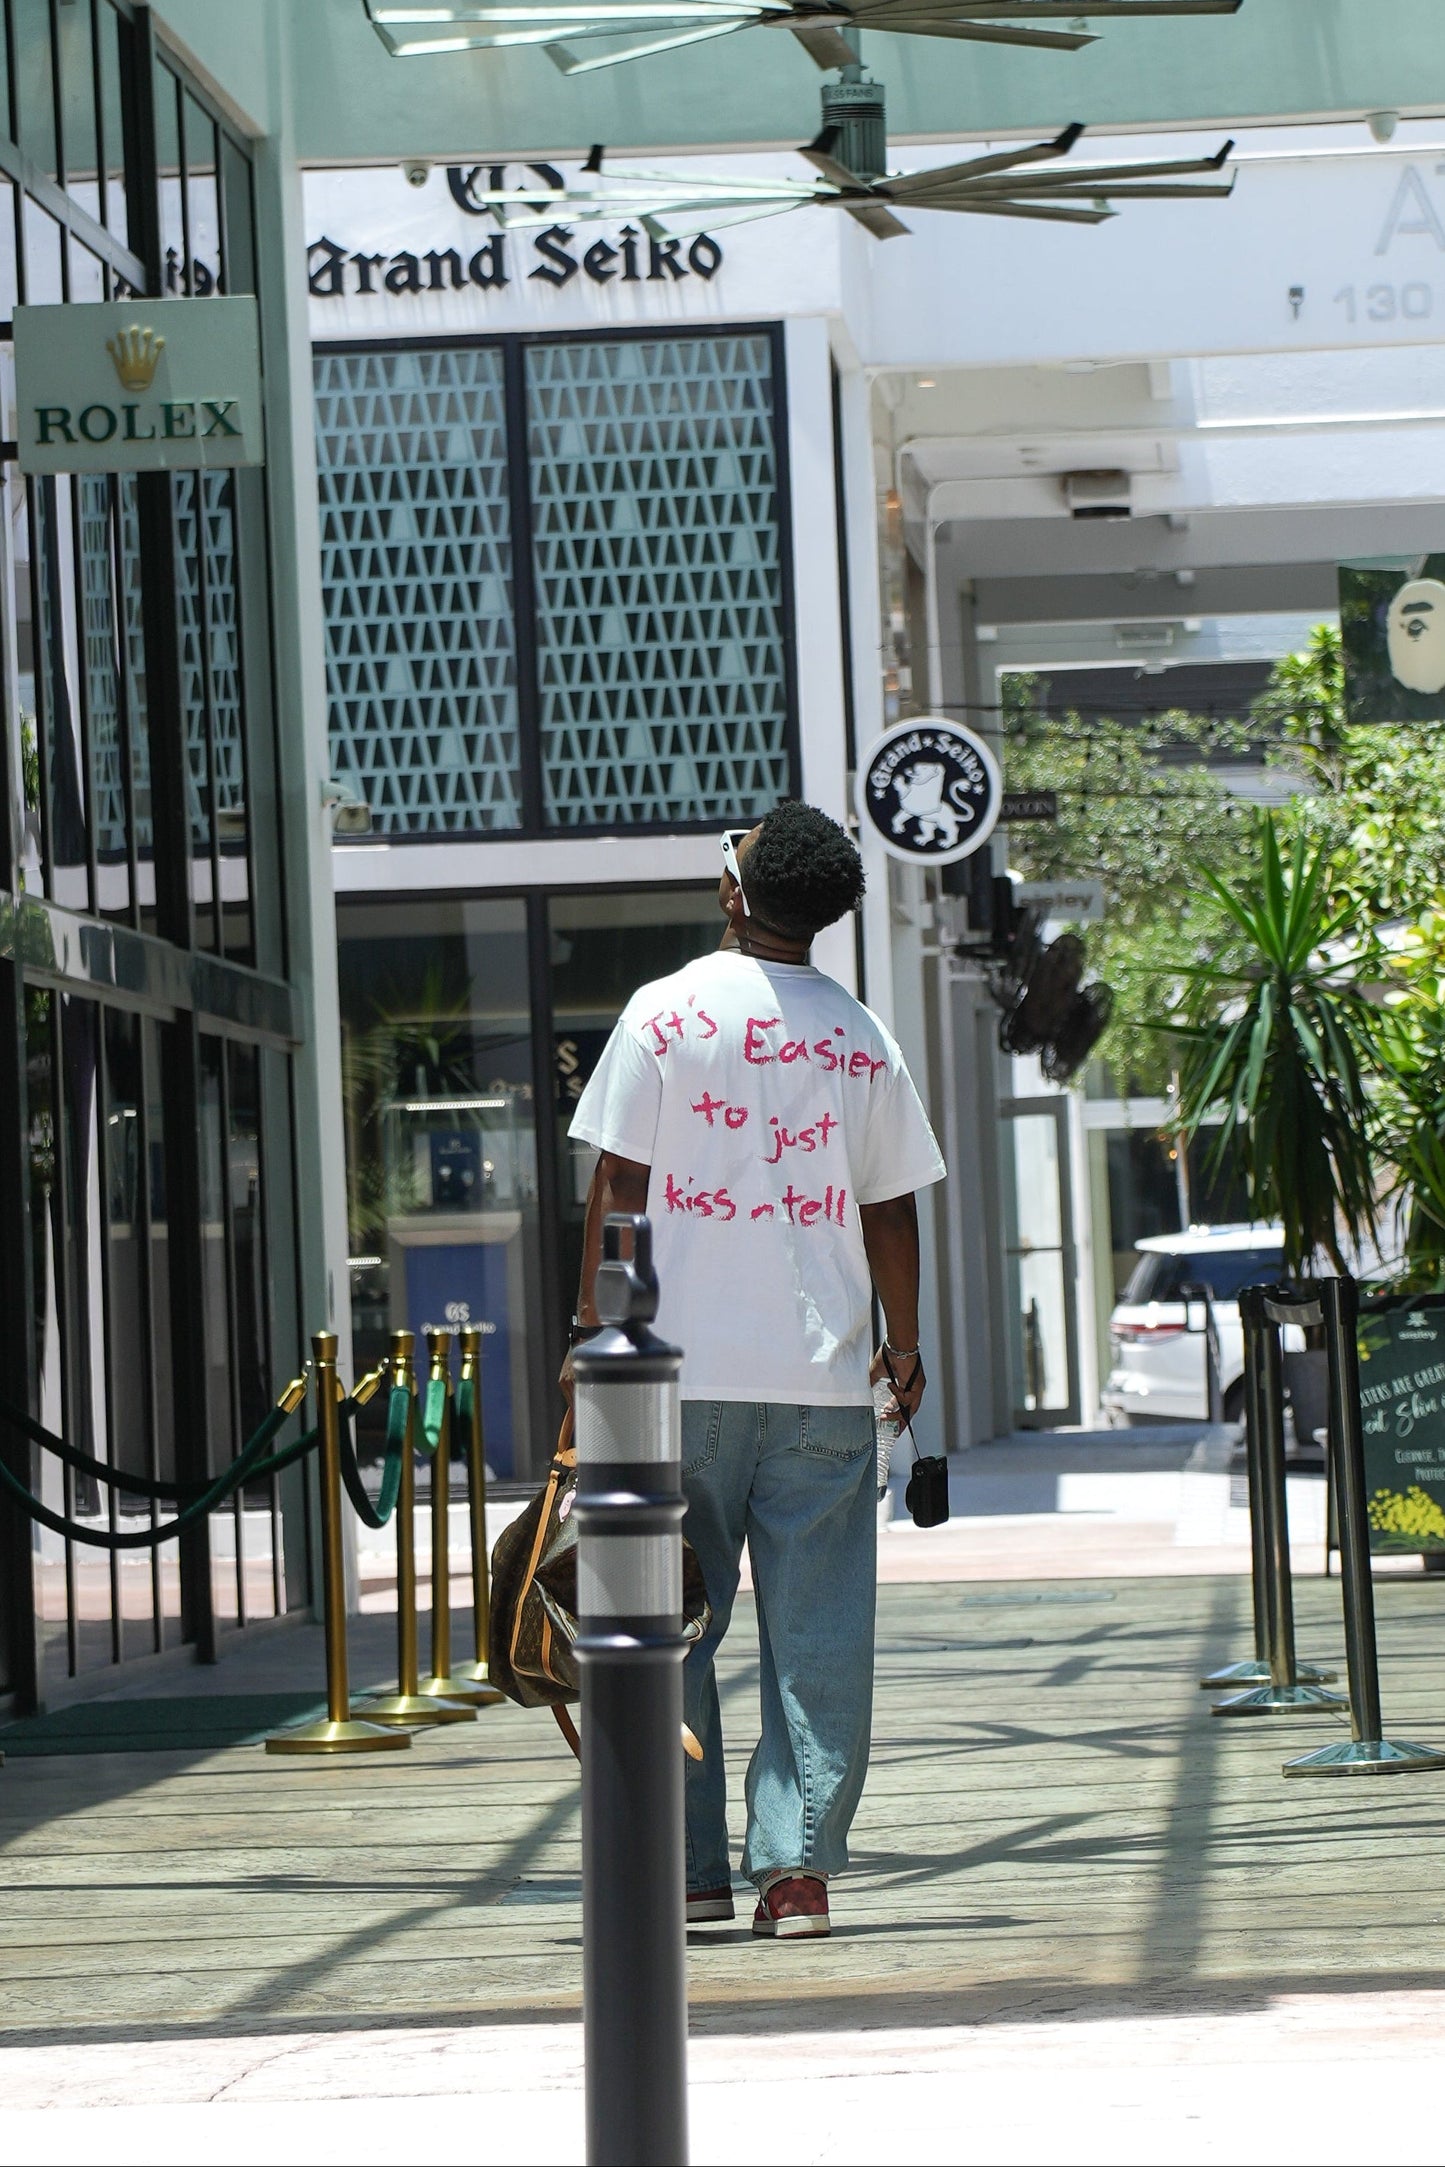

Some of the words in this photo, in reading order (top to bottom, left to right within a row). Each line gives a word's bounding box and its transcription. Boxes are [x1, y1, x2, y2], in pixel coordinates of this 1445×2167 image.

[307, 236, 510, 297] Grand
[528, 223, 722, 289] Seiko
[1332, 281, 1433, 324] 130
[34, 401, 243, 445] ROLEX
[870, 732, 922, 788] Grand
[934, 732, 985, 783] Seiko
[641, 994, 718, 1057] It's
[744, 1018, 889, 1083] Easier
[689, 1091, 748, 1130] to
[759, 1112, 839, 1164] just
[663, 1173, 737, 1222] kiss
[1391, 1375, 1416, 1396] ARE
